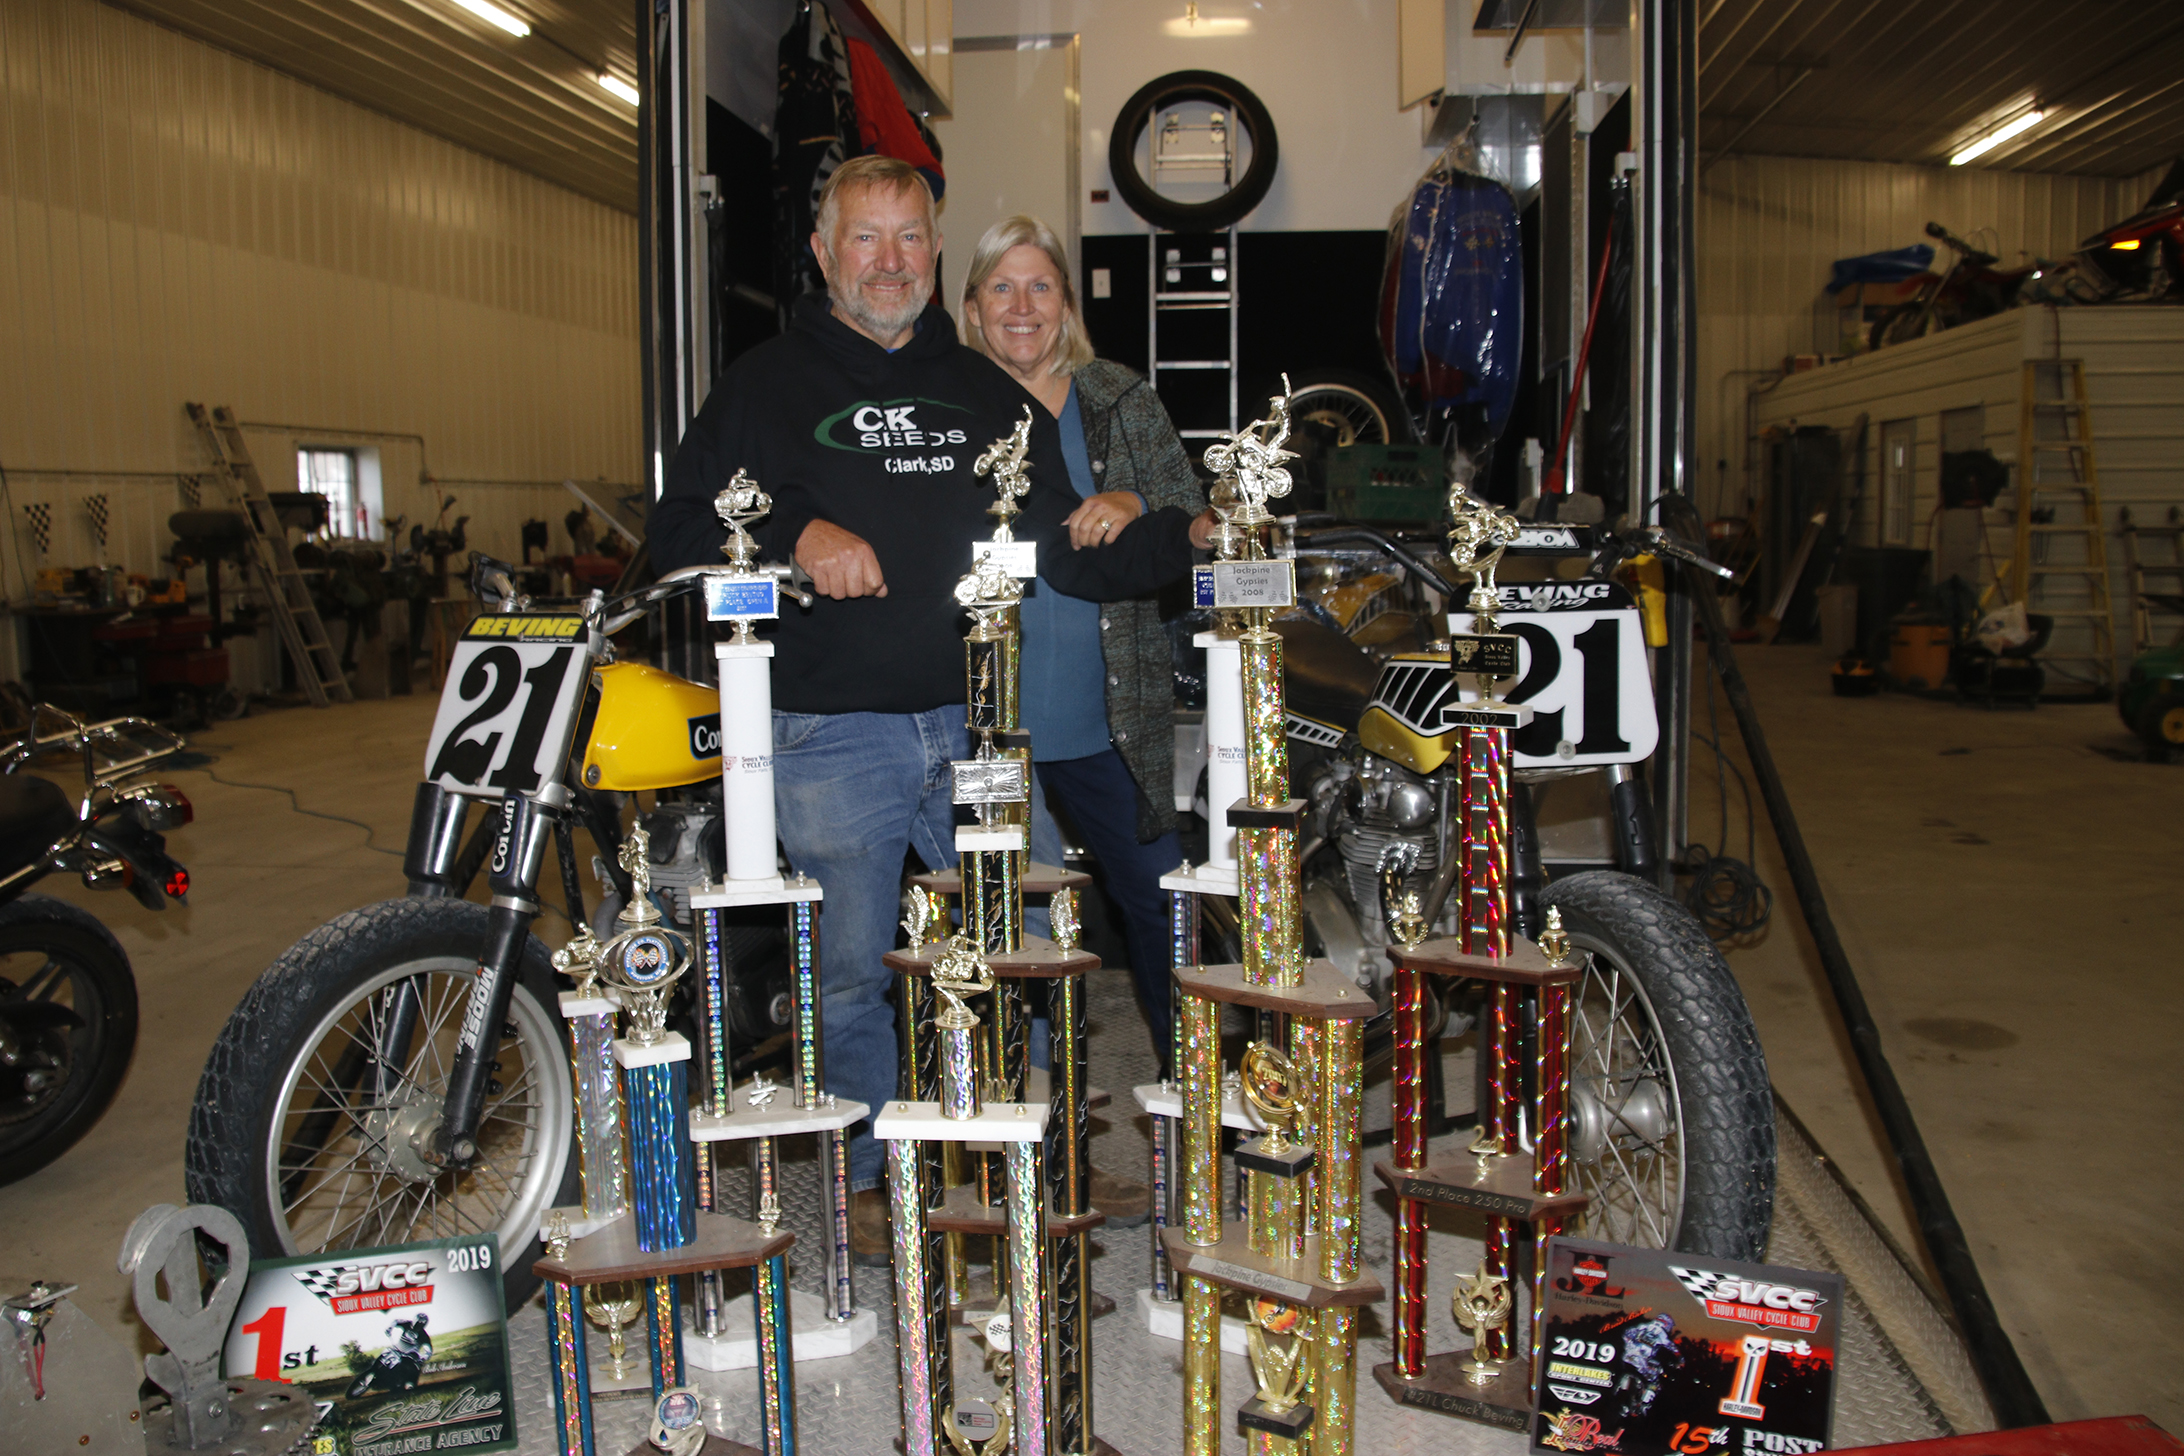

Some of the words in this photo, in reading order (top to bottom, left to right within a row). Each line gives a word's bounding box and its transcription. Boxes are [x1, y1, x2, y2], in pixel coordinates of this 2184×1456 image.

[853, 406, 917, 432] CK
[860, 429, 967, 447] SEEDS
[1233, 565, 1271, 576] Jackpine
[1236, 576, 1268, 587] Gypsies
[1242, 588, 1264, 596] 2008
[467, 617, 583, 637] BEVING
[1483, 643, 1512, 654] SVCC
[1496, 618, 1632, 758] 21
[428, 645, 575, 792] 21
[1461, 712, 1498, 725] 2002
[464, 966, 495, 1051] MOOSE
[1409, 1182, 1435, 1197] 2nd
[1438, 1187, 1471, 1203] Place
[1474, 1194, 1502, 1209] 250
[1505, 1200, 1526, 1214] Pro
[447, 1244, 492, 1273] 2019
[336, 1262, 428, 1295] SVCC
[1211, 1262, 1252, 1282] Jackpine
[337, 1300, 359, 1313] SIOUX
[361, 1296, 385, 1310] VALLEY
[386, 1293, 407, 1307] CYCLE
[410, 1289, 428, 1303] CLUB
[1714, 1280, 1818, 1311] SVCC
[1712, 1303, 1735, 1316] SIOUX
[1737, 1307, 1763, 1321] VALLEY
[1765, 1311, 1789, 1325] CYCLE
[1791, 1315, 1810, 1328] CLUB
[242, 1306, 319, 1385] 1st
[1551, 1336, 1616, 1364] 2019
[1550, 1362, 1611, 1381] INTERLAKES
[352, 1399, 442, 1446] State
[439, 1386, 501, 1425] Line
[1442, 1397, 1480, 1416] Chuck
[1483, 1407, 1525, 1430] Beving
[437, 1423, 503, 1449] AGENCY
[1669, 1422, 1731, 1454] 15th
[1742, 1428, 1824, 1455] POST
